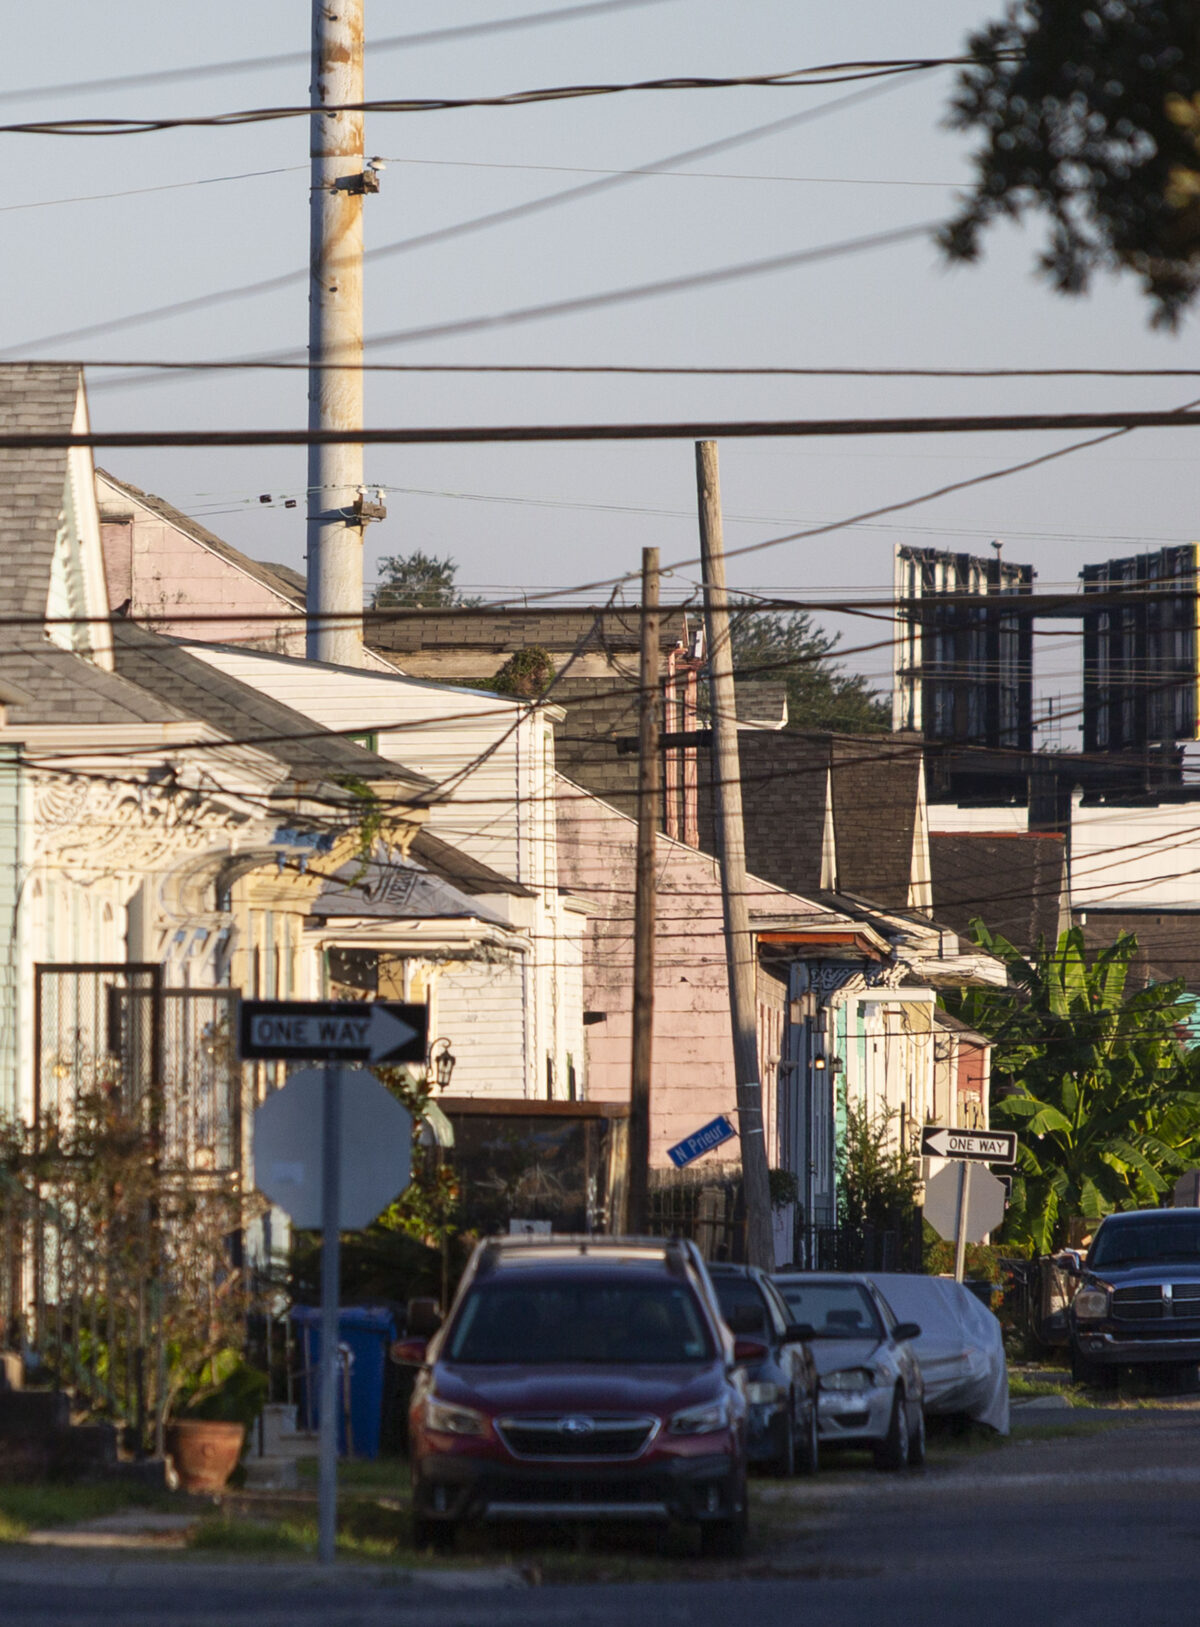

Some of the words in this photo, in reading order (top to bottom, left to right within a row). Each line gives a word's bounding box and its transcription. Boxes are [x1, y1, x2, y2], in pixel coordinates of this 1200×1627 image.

[257, 1018, 308, 1045] ONE
[318, 1018, 371, 1044] WAY
[674, 1146, 688, 1162] N
[687, 1124, 724, 1155] Prieur
[949, 1137, 975, 1151] ONE
[979, 1140, 1006, 1154] WAY
